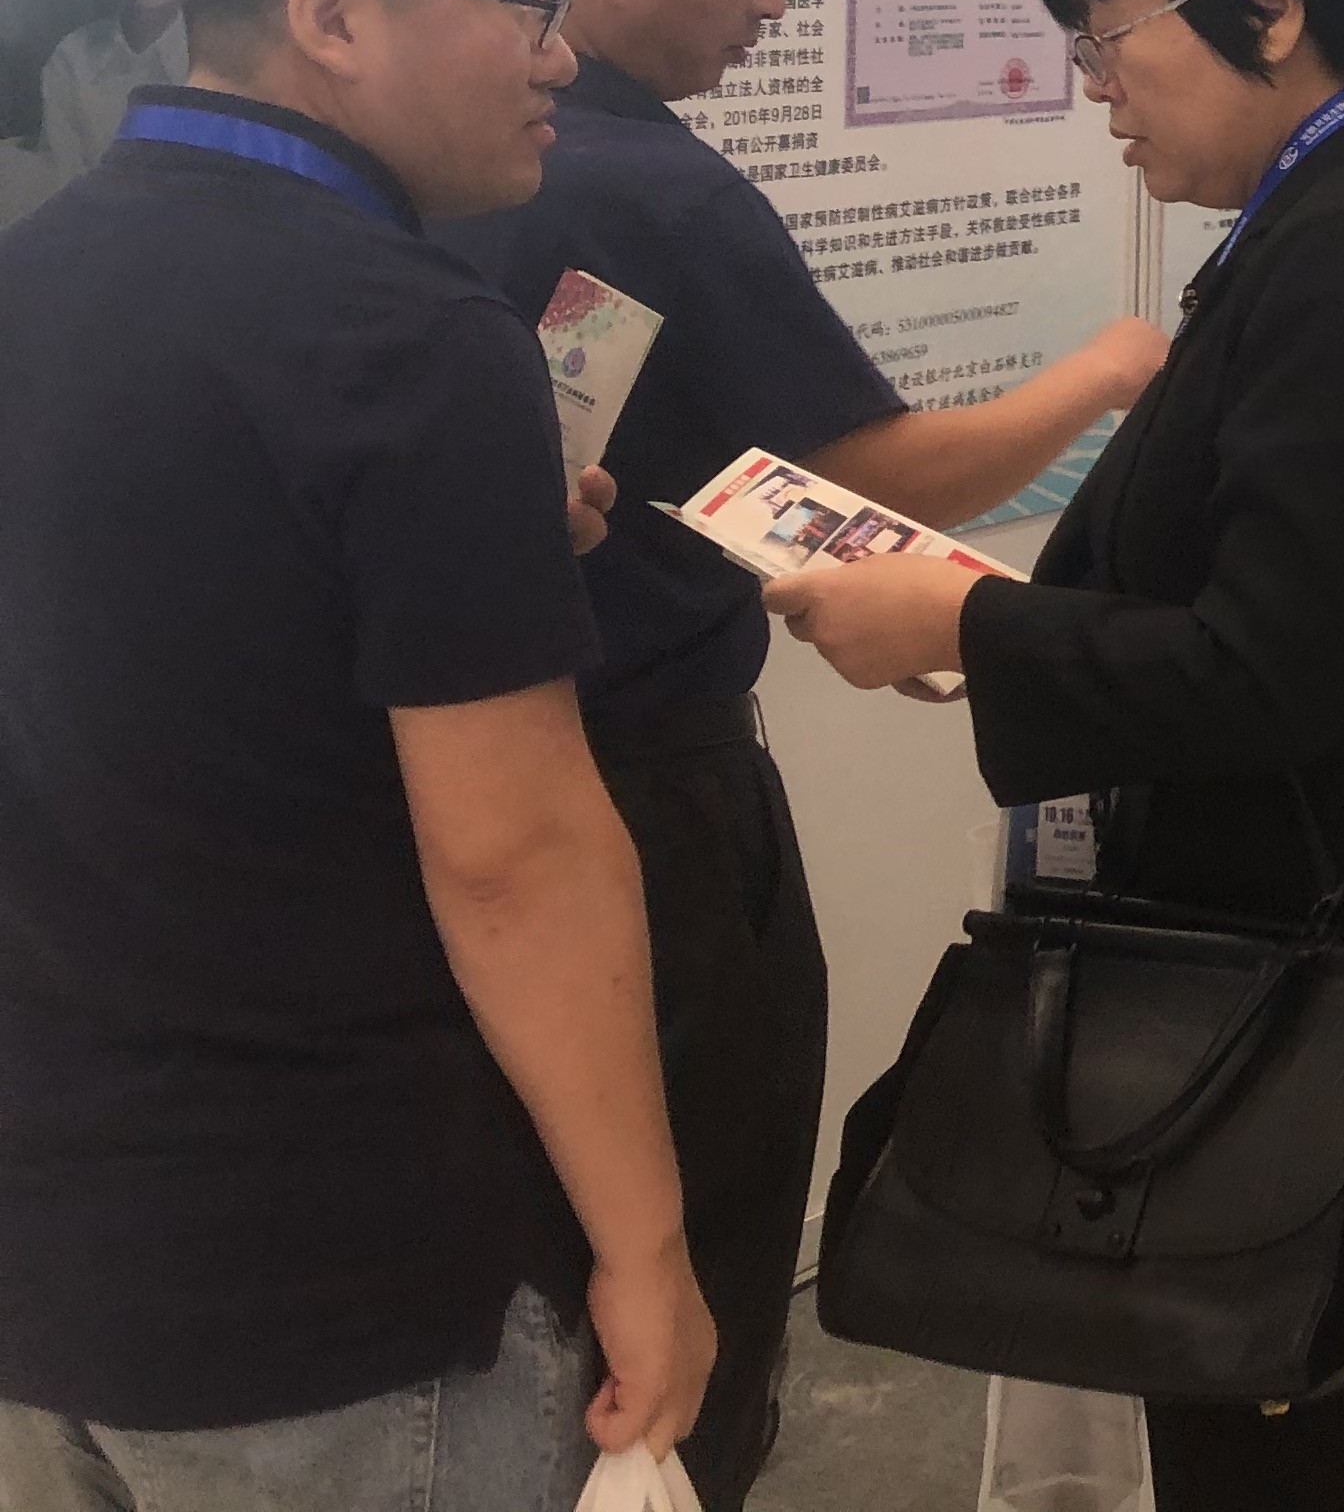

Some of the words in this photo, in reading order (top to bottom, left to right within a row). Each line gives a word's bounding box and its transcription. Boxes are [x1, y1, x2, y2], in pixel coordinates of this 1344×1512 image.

[727, 47, 825, 69] 的非营利性社
[683, 75, 824, 101] 独立法人资格的全
[737, 154, 888, 183] 是国家卫生健康委员会。
